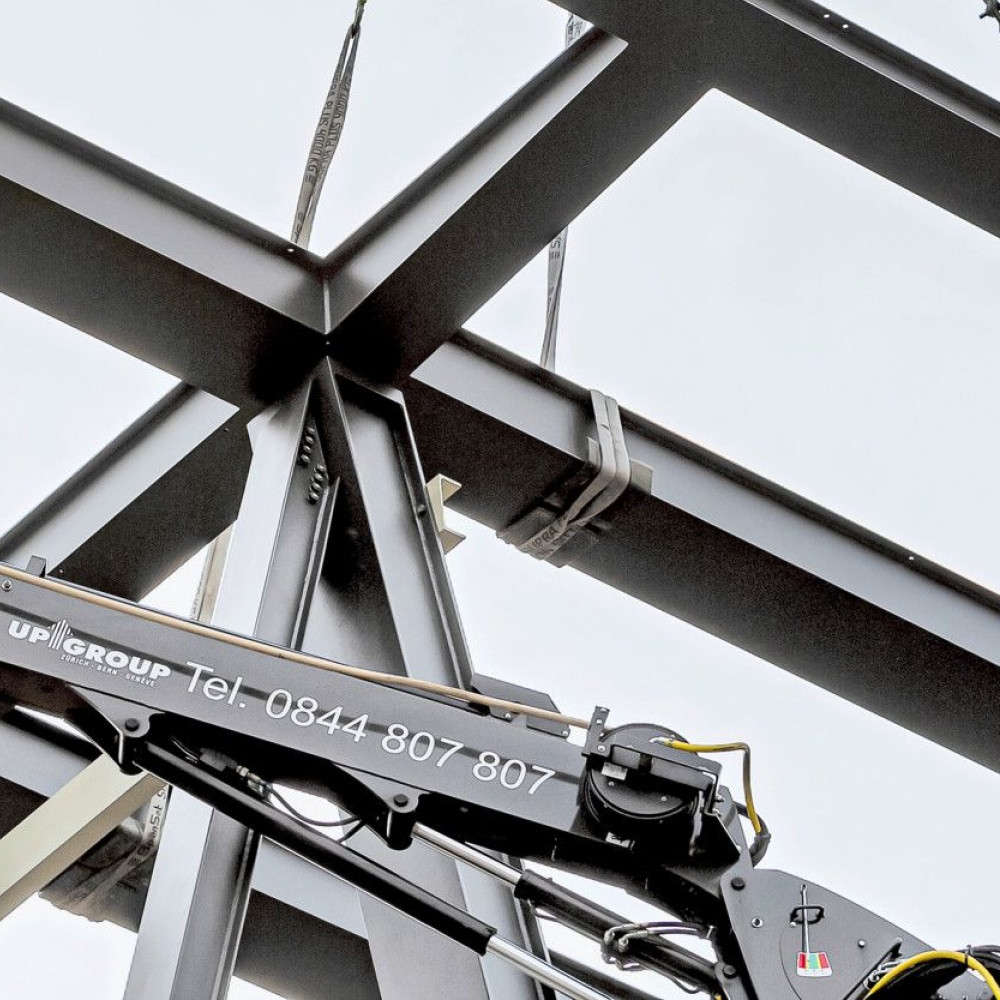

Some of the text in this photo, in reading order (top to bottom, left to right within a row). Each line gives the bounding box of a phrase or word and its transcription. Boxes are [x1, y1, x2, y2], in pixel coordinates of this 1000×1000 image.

[312, 127, 327, 156] 4000
[8, 620, 172, 680] UP GROUP
[97, 664, 118, 676] BERN
[187, 661, 556, 795] Tel. 0844 807 807
